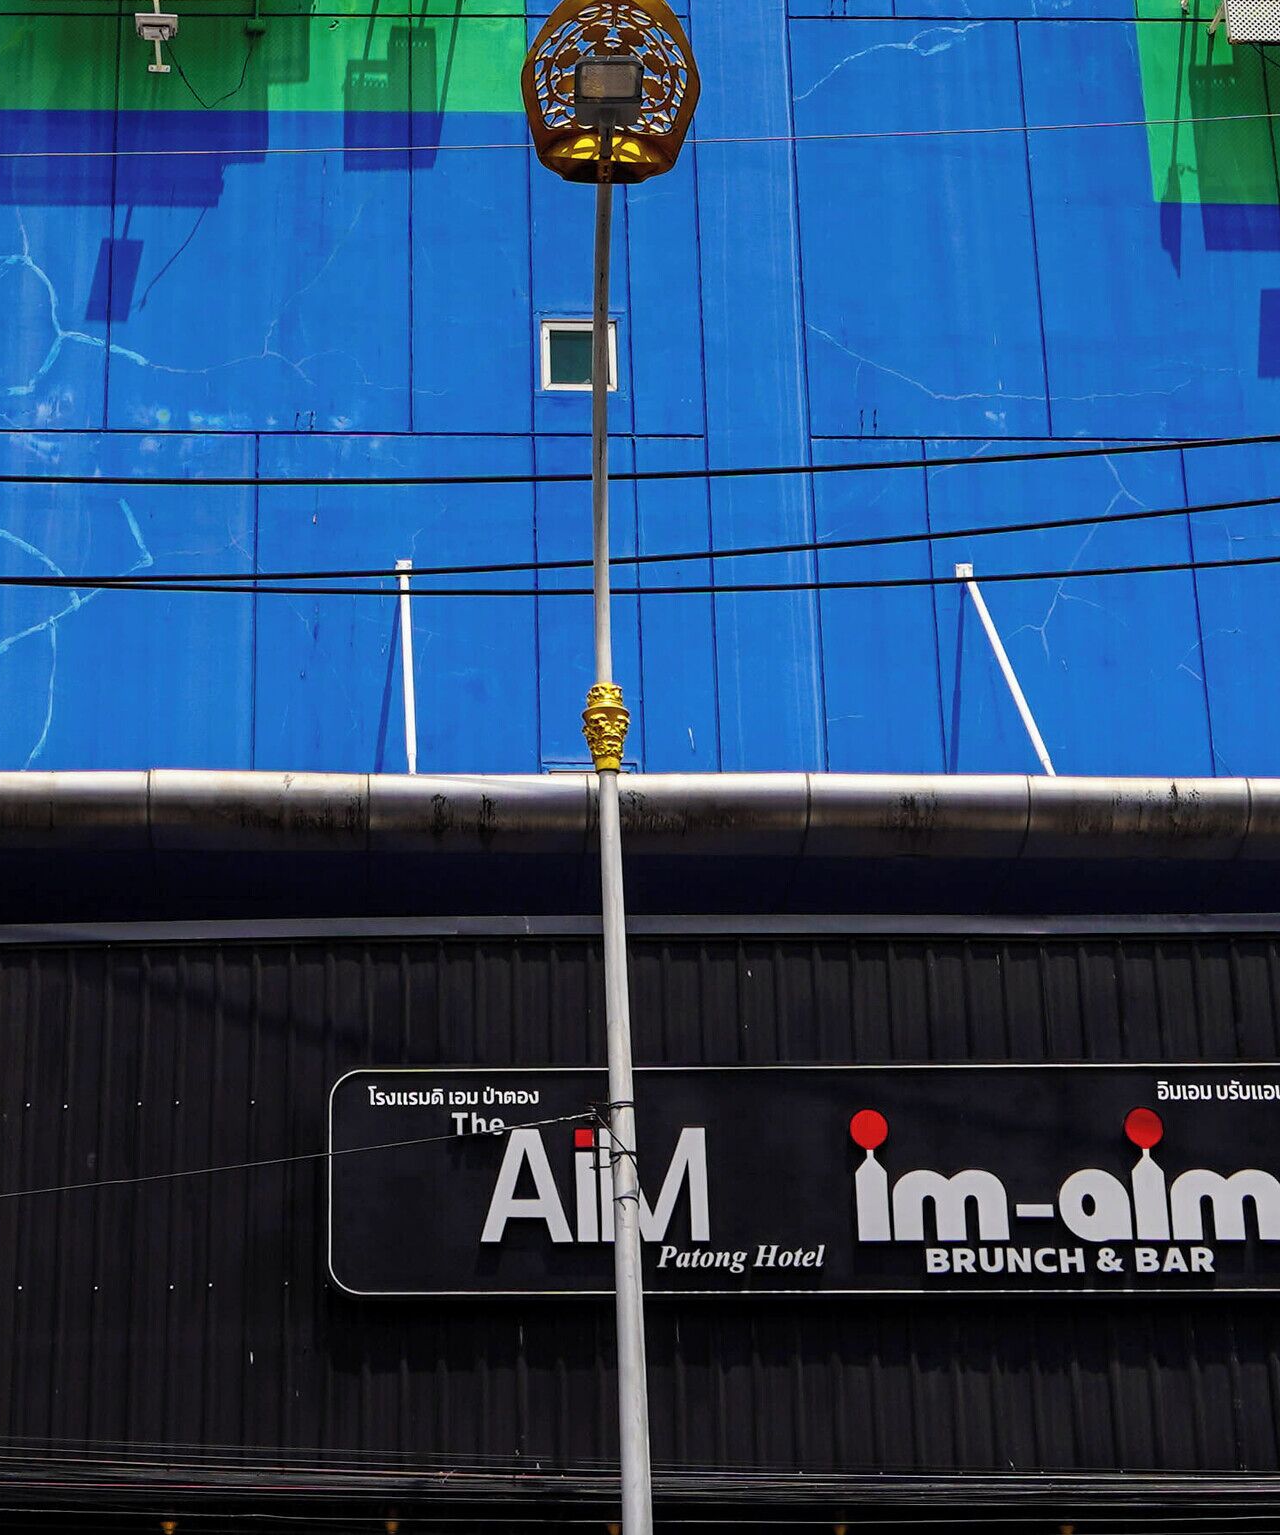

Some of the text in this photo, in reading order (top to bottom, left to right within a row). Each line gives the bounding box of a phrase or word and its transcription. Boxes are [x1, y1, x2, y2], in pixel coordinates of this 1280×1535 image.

[368, 1086, 540, 1106] โรงแรมดิ เอม ป่าตอง
[1157, 1081, 1212, 1100] อิมเอม
[451, 1112, 505, 1136] The
[656, 1244, 825, 1273] Patong Hotel
[925, 1246, 1216, 1273] BRUNCH & BAR
